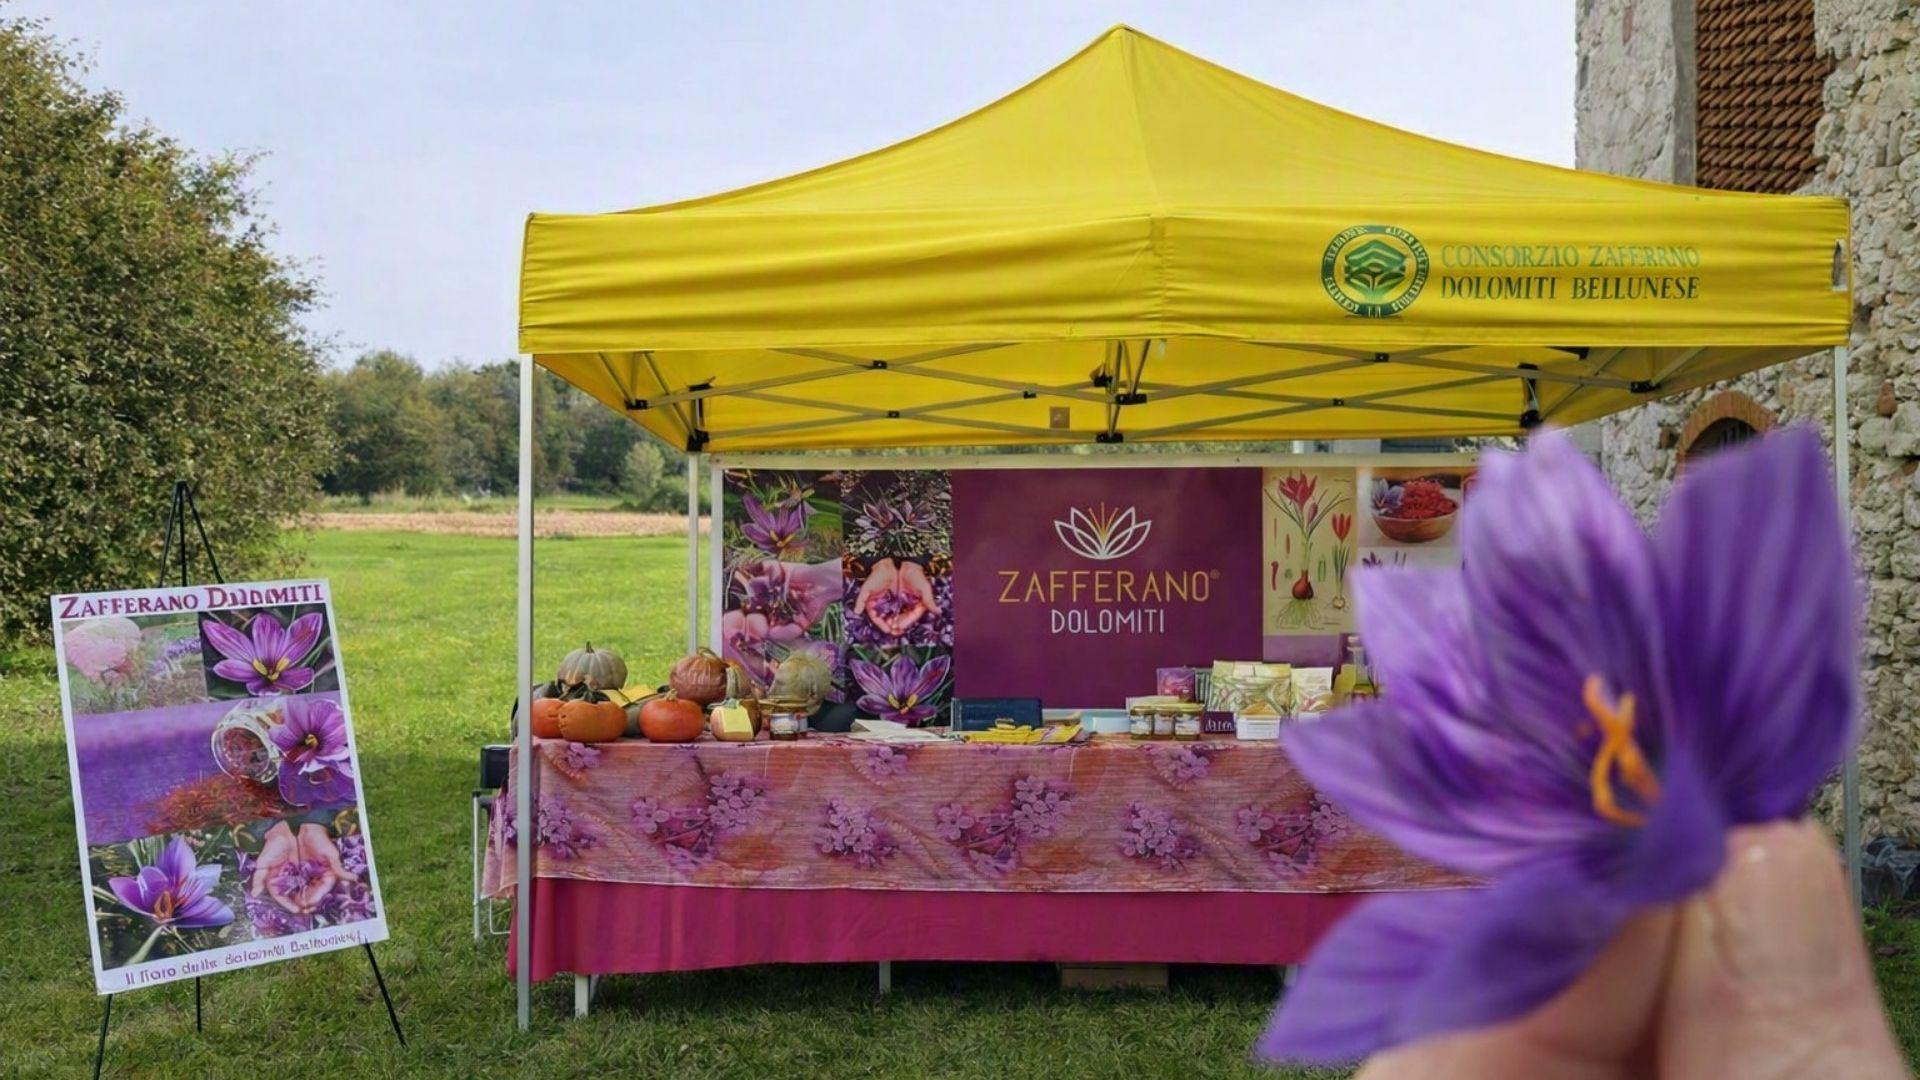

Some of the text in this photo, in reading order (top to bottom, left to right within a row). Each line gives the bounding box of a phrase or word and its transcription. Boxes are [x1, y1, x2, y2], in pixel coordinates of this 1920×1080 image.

[1440, 275, 1700, 300] DOLOMITI BELLUNESE
[59, 593, 199, 619] ZAFFERANO
[1051, 609, 1165, 634] DOLOMITI
